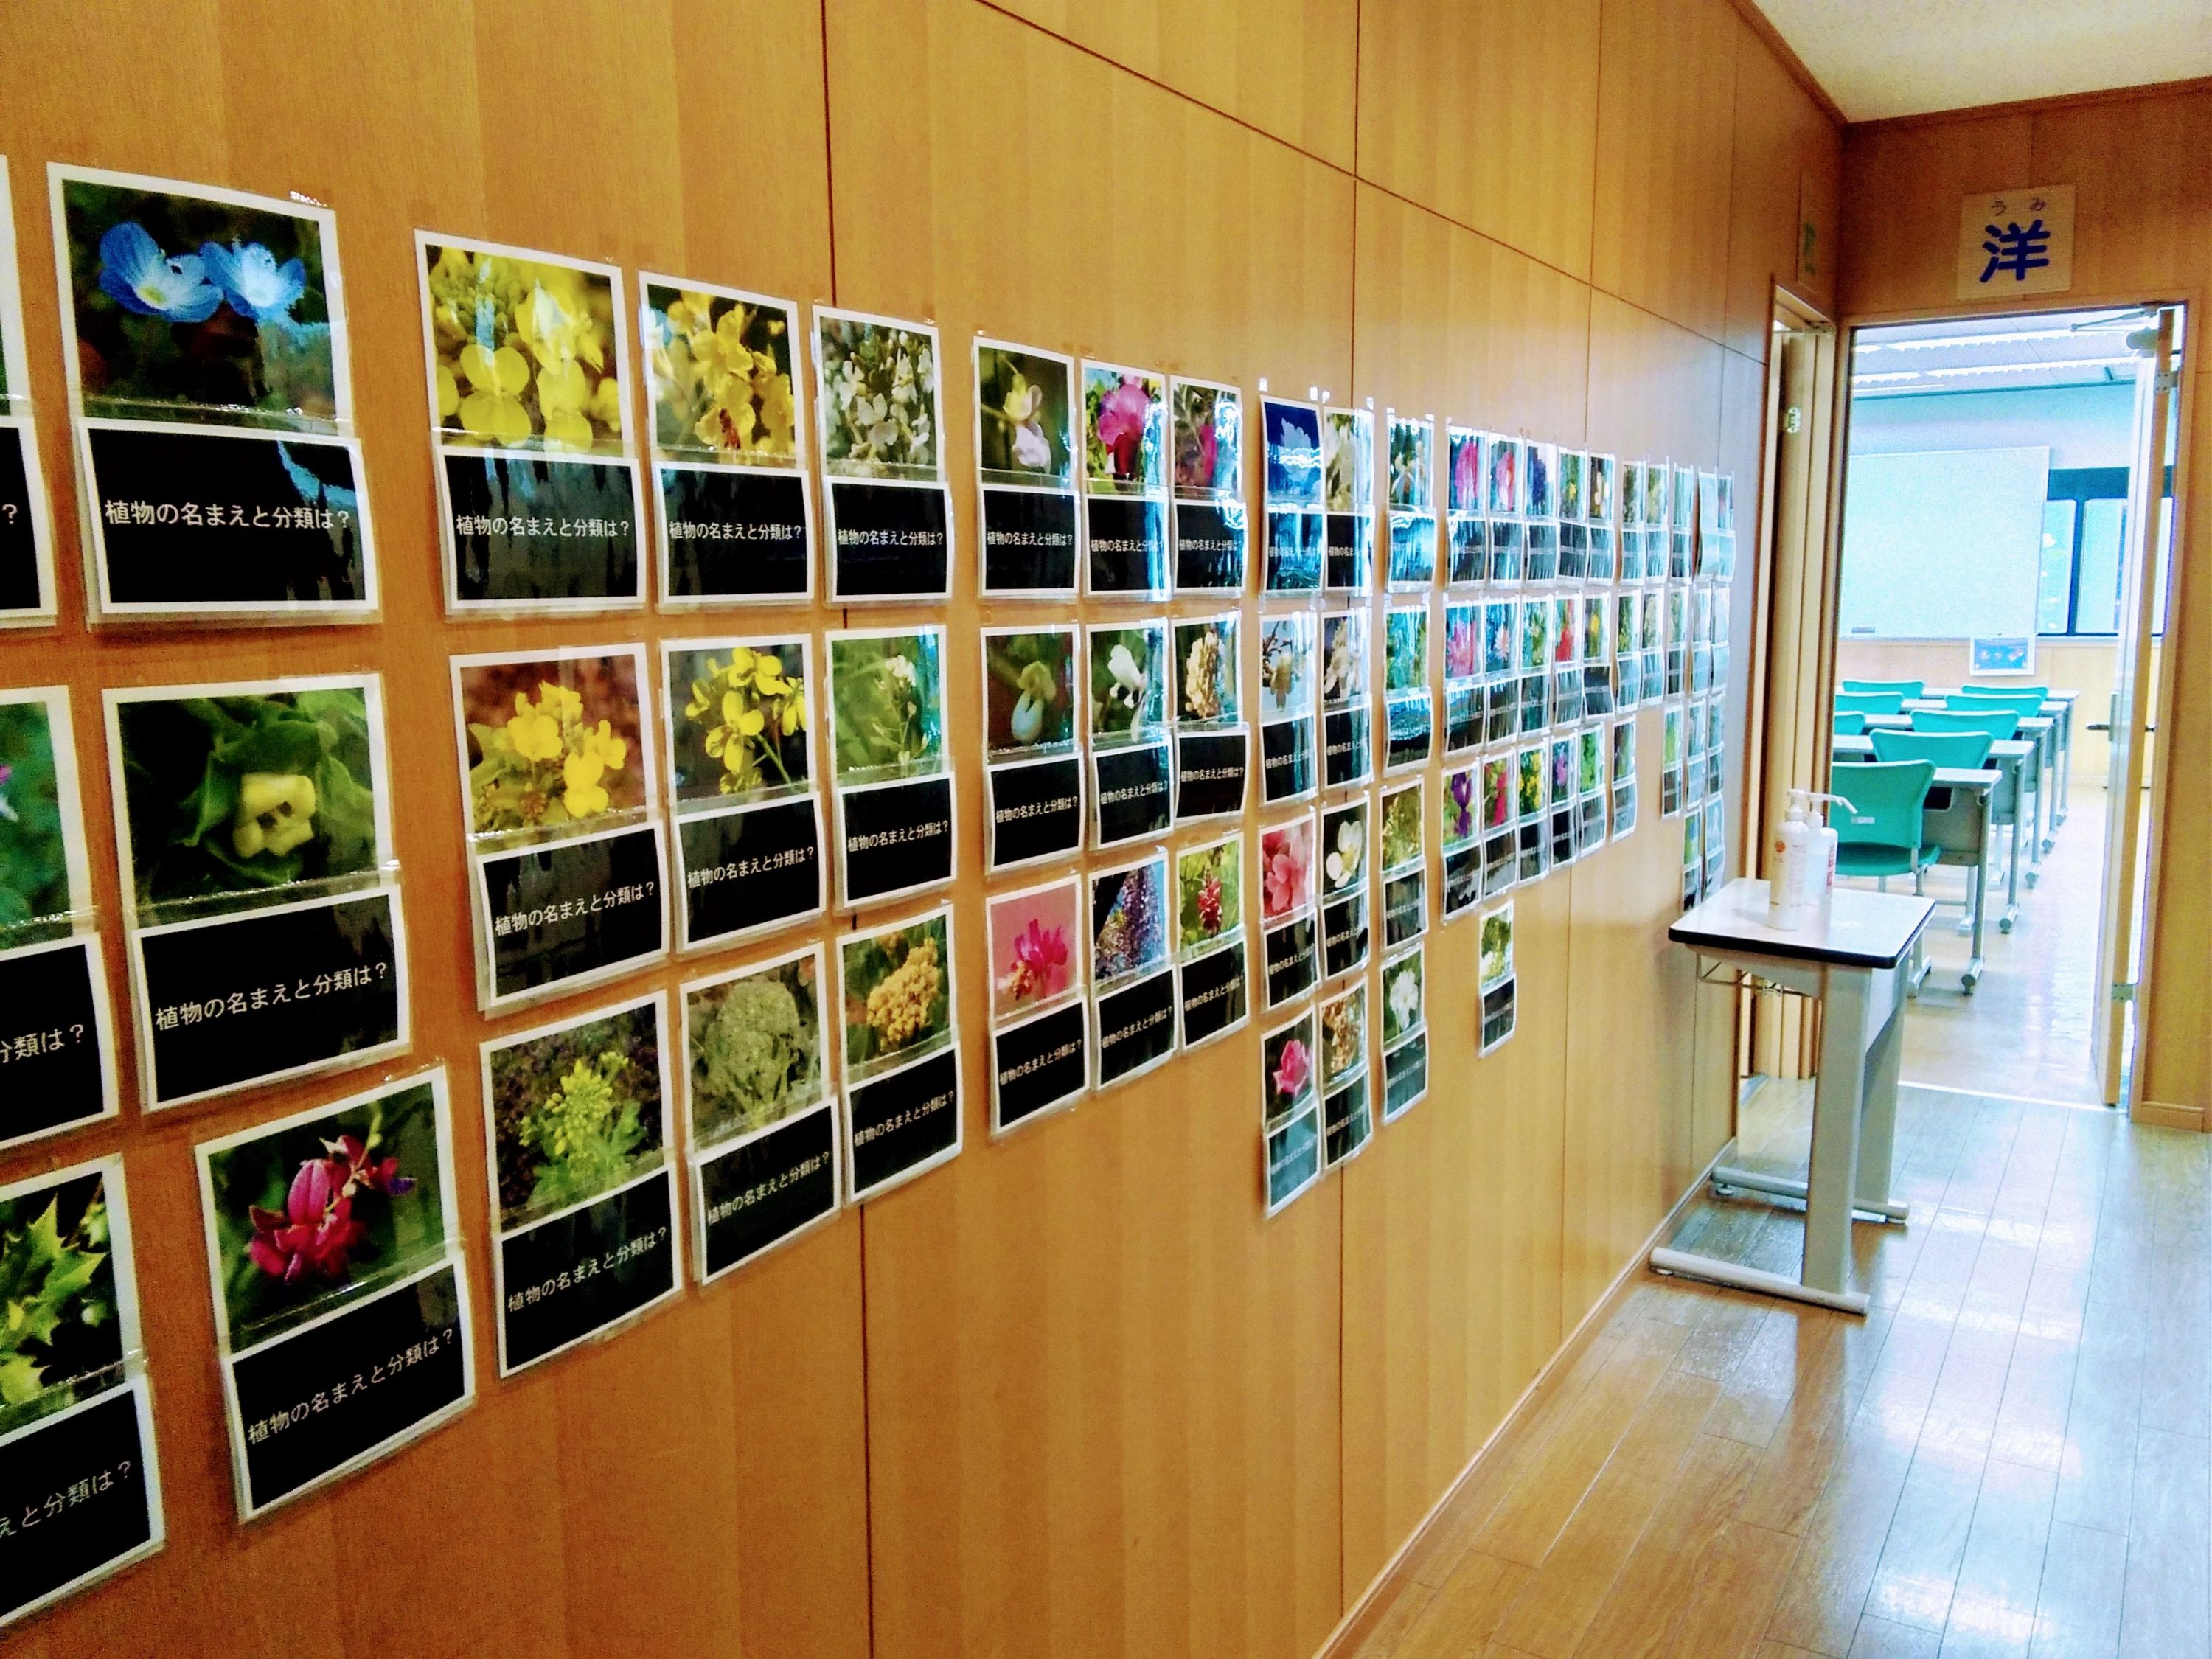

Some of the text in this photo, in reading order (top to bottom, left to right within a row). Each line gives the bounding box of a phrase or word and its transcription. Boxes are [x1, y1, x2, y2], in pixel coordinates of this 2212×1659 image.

[1980, 219, 2051, 282] 洋
[104, 499, 350, 529] 植物の名まえと分類は？
[456, 515, 630, 538] 植物の名まえと分類は？
[669, 521, 802, 540] 植物の名まえと分類は？
[838, 529, 944, 546] 植物の名まえと分類は？
[987, 532, 1074, 547] 植物の名まえと分類は？
[1178, 538, 1243, 552] 植物の名まえと分類は
[995, 796, 1079, 824] 植物の名まえと分類は？
[848, 820, 949, 852] 植物の名まえと分類は？
[687, 846, 815, 889] 植物の名まえと分類は？
[495, 881, 655, 937] 植物の名まえと分類は？
[155, 961, 387, 1032] 植物の名まえと分類は？
[854, 1090, 956, 1147] 植物の名まえと分類は？
[706, 1150, 830, 1227] 植物の名まえと分類は？
[507, 1226, 667, 1312] 植物の名まえと分類は？
[248, 1328, 454, 1445] 植物の名まえと分類は？
